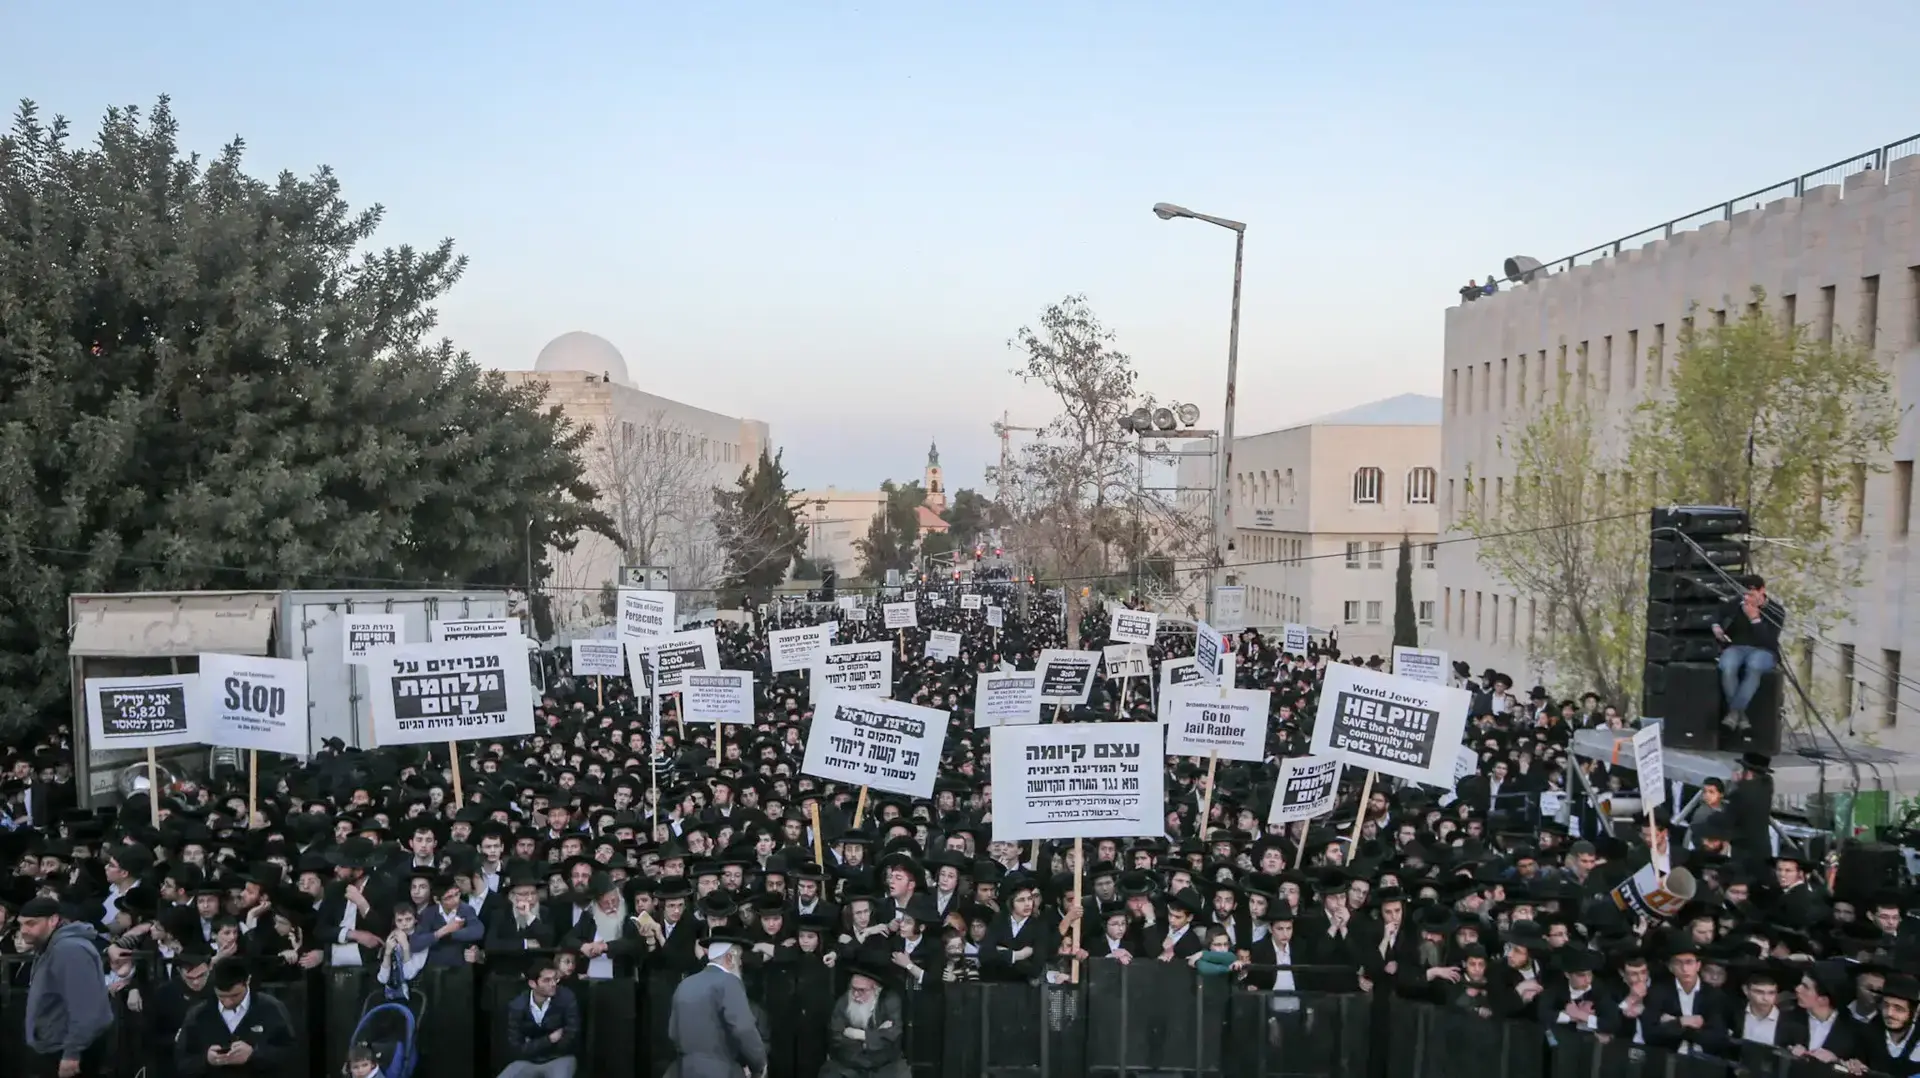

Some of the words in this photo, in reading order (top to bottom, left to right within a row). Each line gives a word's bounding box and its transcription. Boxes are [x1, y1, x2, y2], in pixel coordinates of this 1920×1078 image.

[625, 610, 663, 626] Persecutes
[644, 644, 668, 652] Iseli
[669, 640, 696, 648] Police:
[778, 635, 800, 643] קיומה
[394, 659, 419, 674] על
[426, 655, 500, 672] מכריזים
[661, 656, 683, 666] 3:00
[825, 672, 847, 684] ליהודי
[850, 671, 866, 682] קשה
[869, 670, 881, 680] הכי
[398, 672, 499, 697] מלחמת
[113, 694, 146, 708] עריק
[148, 694, 171, 707] אני
[224, 676, 286, 718] Stop
[1352, 684, 1386, 698] World
[1389, 692, 1428, 707] Jewry:
[421, 694, 480, 716] קיום
[120, 706, 166, 719] 15,820
[457, 712, 489, 726] לביטול
[492, 713, 506, 724] עד
[841, 707, 882, 726] ישראל
[1202, 710, 1217, 722] Go
[1220, 712, 1231, 724] to
[1344, 696, 1430, 732] HELP!!!
[112, 718, 148, 730] למאסר
[150, 719, 175, 731] מוכן
[428, 718, 454, 728] גזירת
[884, 717, 922, 734] מדינת
[1184, 722, 1204, 734] Jail
[1206, 723, 1246, 738] Rather
[1342, 716, 1368, 730] SAVE
[1368, 721, 1385, 734] the
[1386, 726, 1426, 742] Charedi
[854, 727, 864, 737] בו
[868, 730, 902, 744] המקום
[1350, 728, 1402, 748] community
[1404, 739, 1414, 750] in
[830, 736, 865, 756] ליהודי
[1336, 734, 1372, 753] Eretz
[868, 744, 896, 764] קשה
[901, 749, 920, 767] הכי
[1026, 744, 1086, 762] קיומה
[1094, 744, 1140, 758] עצם
[825, 756, 860, 770] יהדותו
[864, 762, 878, 774] על
[1028, 765, 1070, 775] הציונית
[1074, 764, 1116, 774] המדינה
[1120, 762, 1138, 773] של
[880, 766, 916, 781] לשמור
[1292, 766, 1305, 776] על
[1027, 779, 1066, 794] הקדושה
[1069, 778, 1098, 791] התורה
[1102, 778, 1118, 790] נגד
[1122, 777, 1139, 790] הוא
[1288, 772, 1334, 792] מלחמת
[1296, 786, 1324, 803] קיום
[1028, 799, 1064, 808] ומייחלים
[1065, 798, 1106, 806] מתפללים
[1122, 798, 1138, 806] לכן
[1048, 810, 1080, 818] במהרה
[1082, 808, 1119, 816] לביטולה
